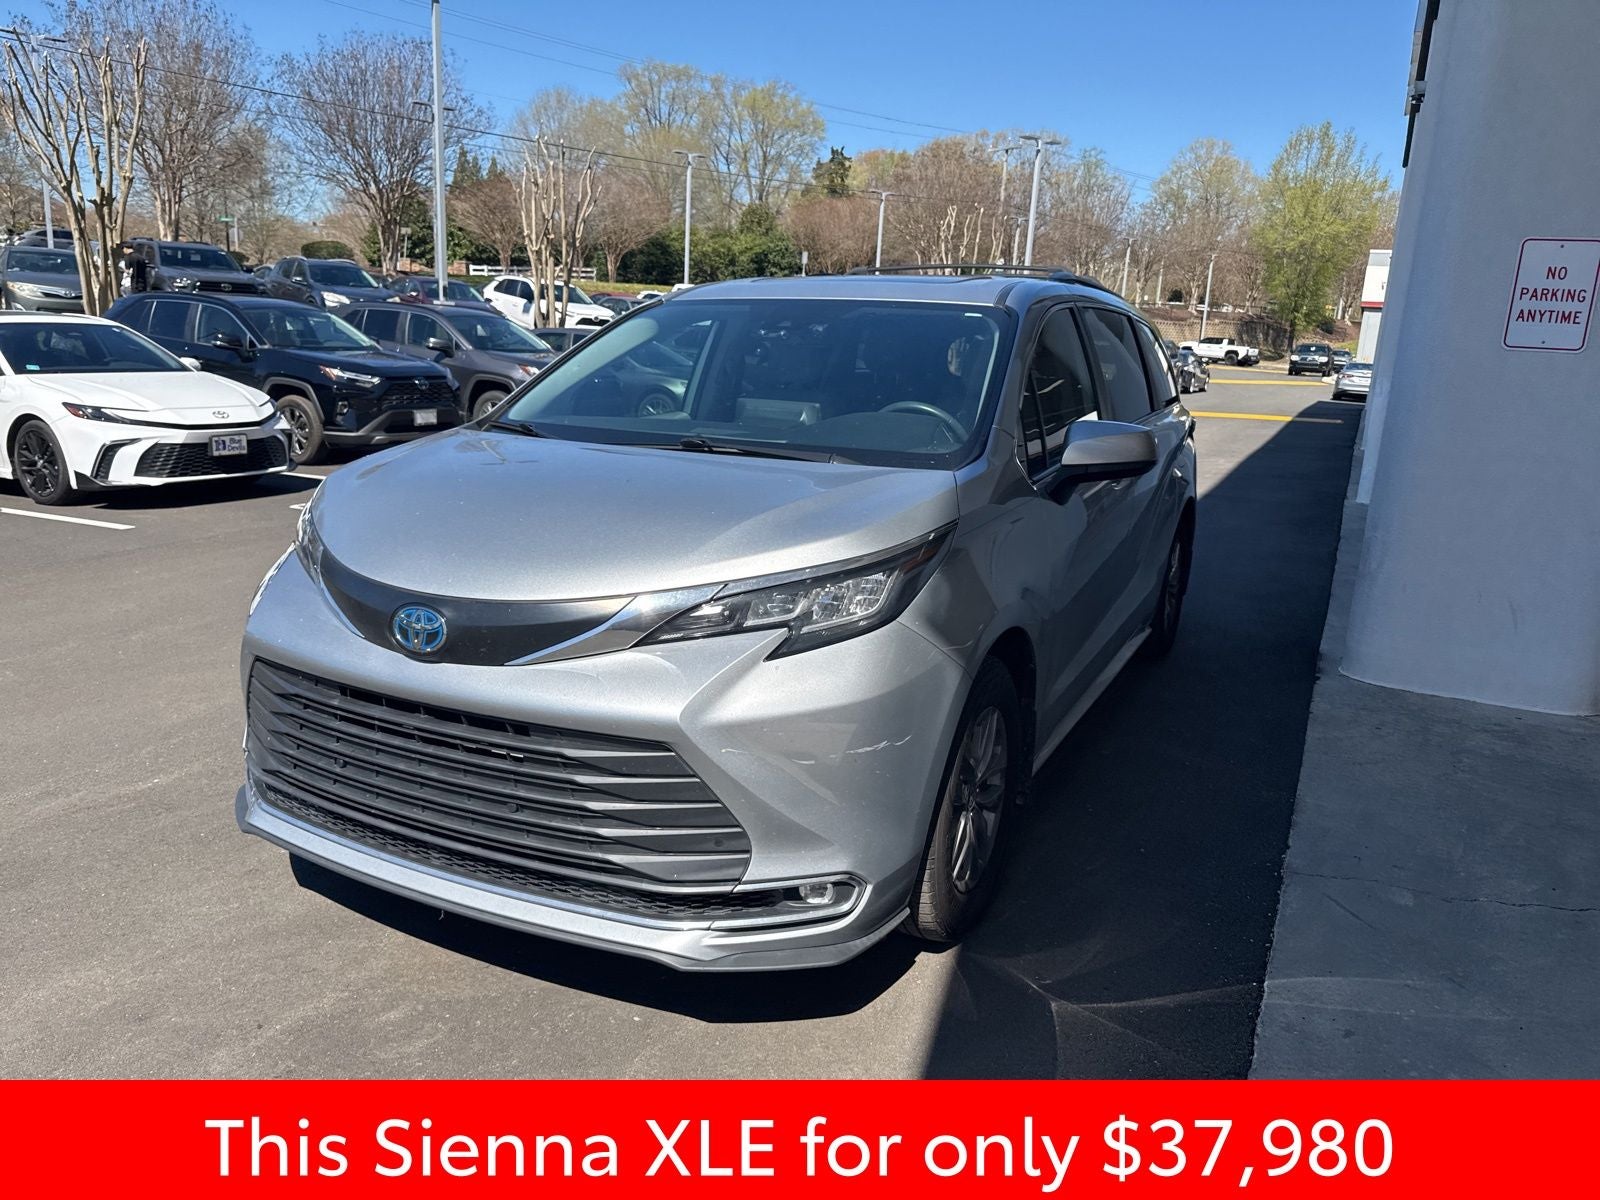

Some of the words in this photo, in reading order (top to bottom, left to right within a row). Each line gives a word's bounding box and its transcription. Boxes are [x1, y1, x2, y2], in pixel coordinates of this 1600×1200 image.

[1546, 266, 1568, 280] NO
[1519, 287, 1587, 303] PARKING
[1515, 308, 1582, 325] ANYTIME
